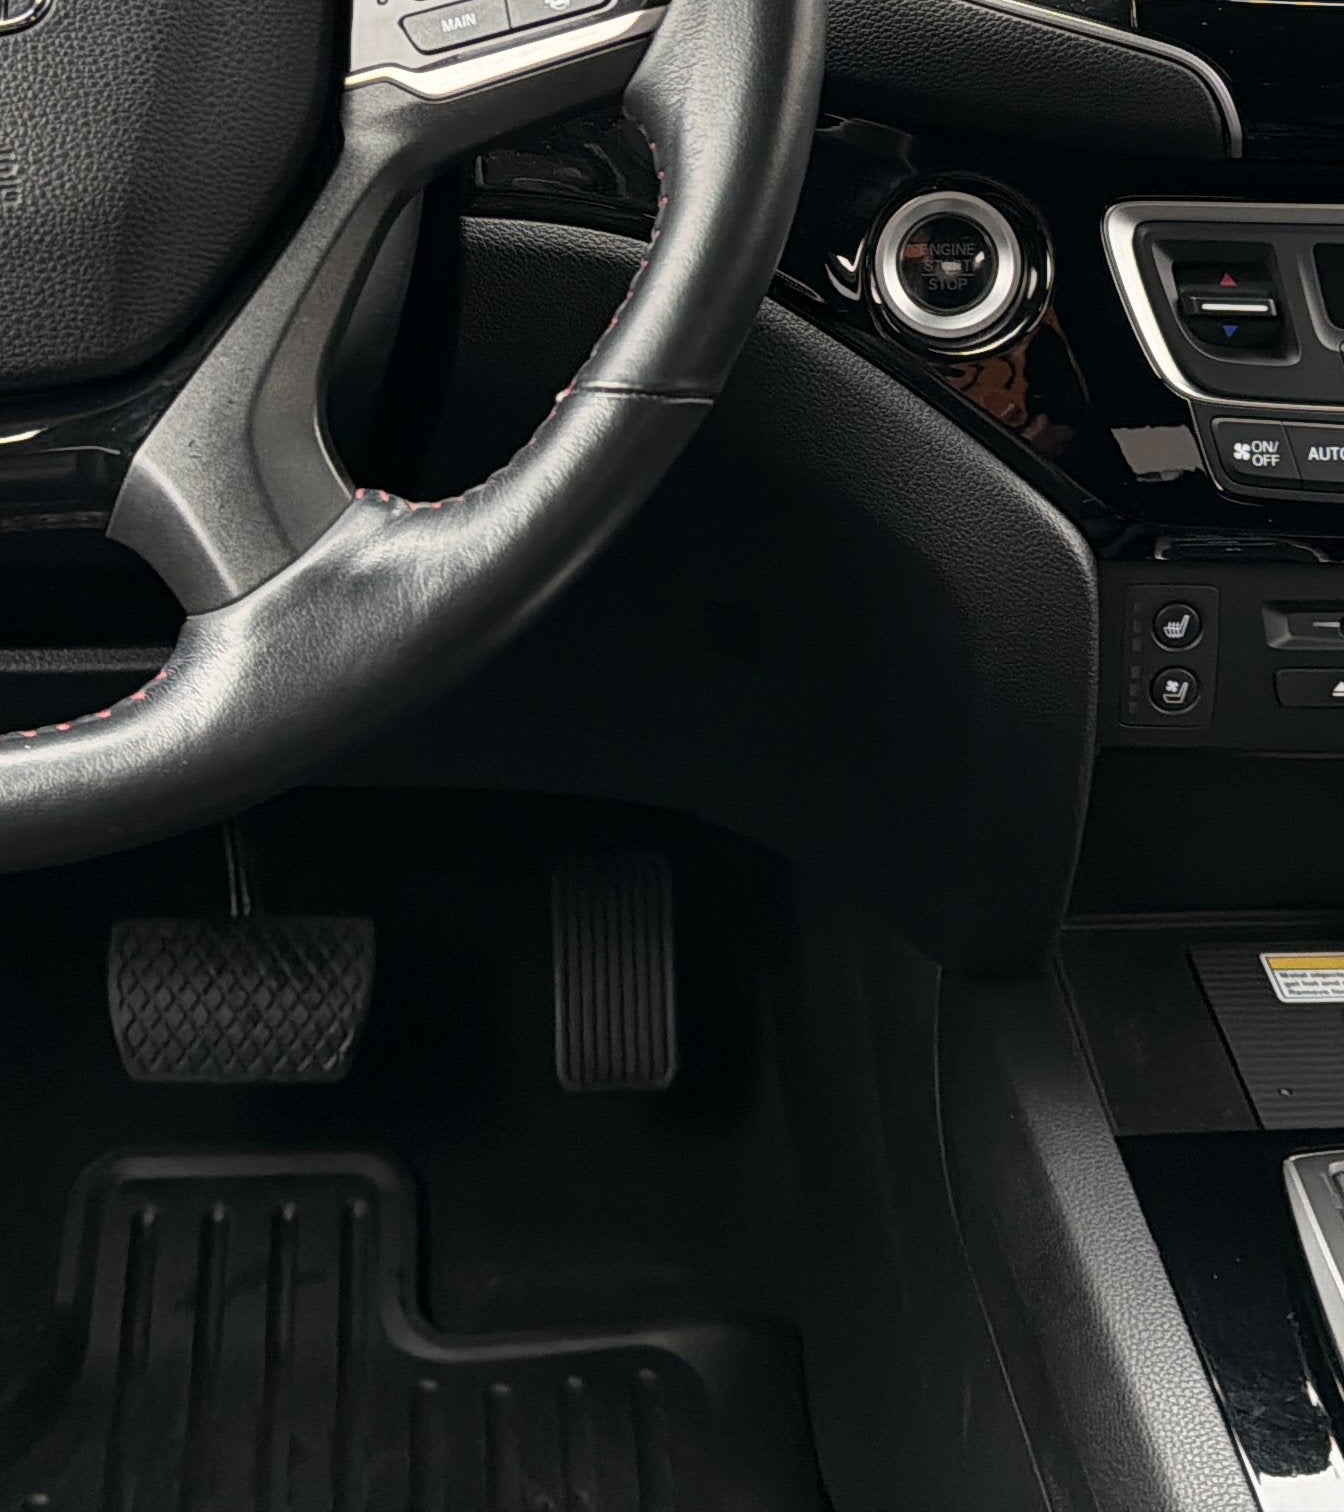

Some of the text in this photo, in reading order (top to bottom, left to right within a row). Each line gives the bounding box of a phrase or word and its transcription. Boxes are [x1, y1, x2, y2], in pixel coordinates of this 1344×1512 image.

[441, 13, 477, 34] MAIN
[928, 278, 968, 291] STOP
[1251, 440, 1279, 453] ON/
[1251, 453, 1280, 467] OFF
